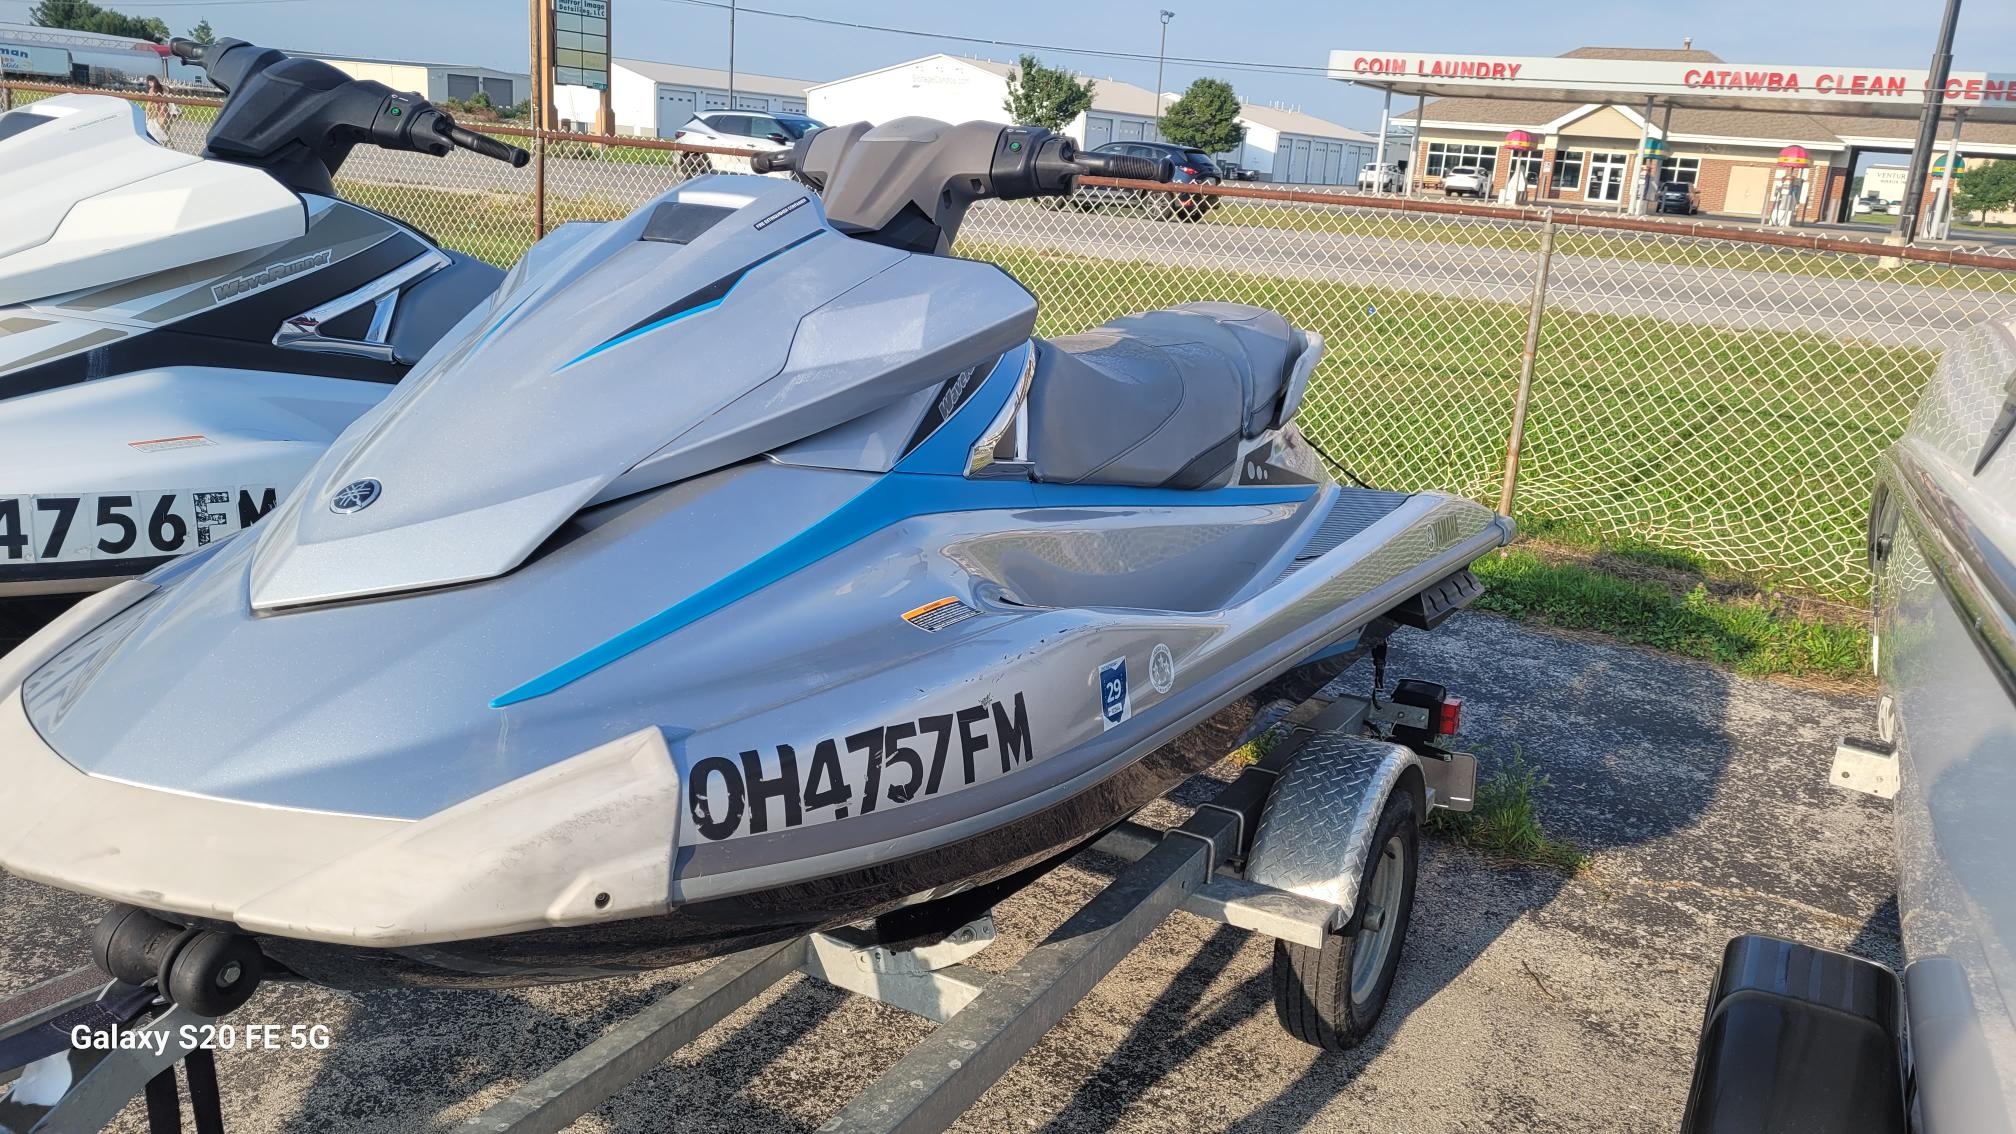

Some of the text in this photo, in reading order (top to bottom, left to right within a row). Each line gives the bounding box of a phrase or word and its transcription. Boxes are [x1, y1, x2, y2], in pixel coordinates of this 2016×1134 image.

[584, 1, 605, 10] Image
[1353, 57, 1522, 80] COIN LAUNDRY
[1683, 69, 2016, 101] CATAWBA CLEAN CENE
[212, 249, 331, 303] WaveRunner
[1106, 678, 1122, 704] 29
[688, 691, 1033, 841] OH4757FM
